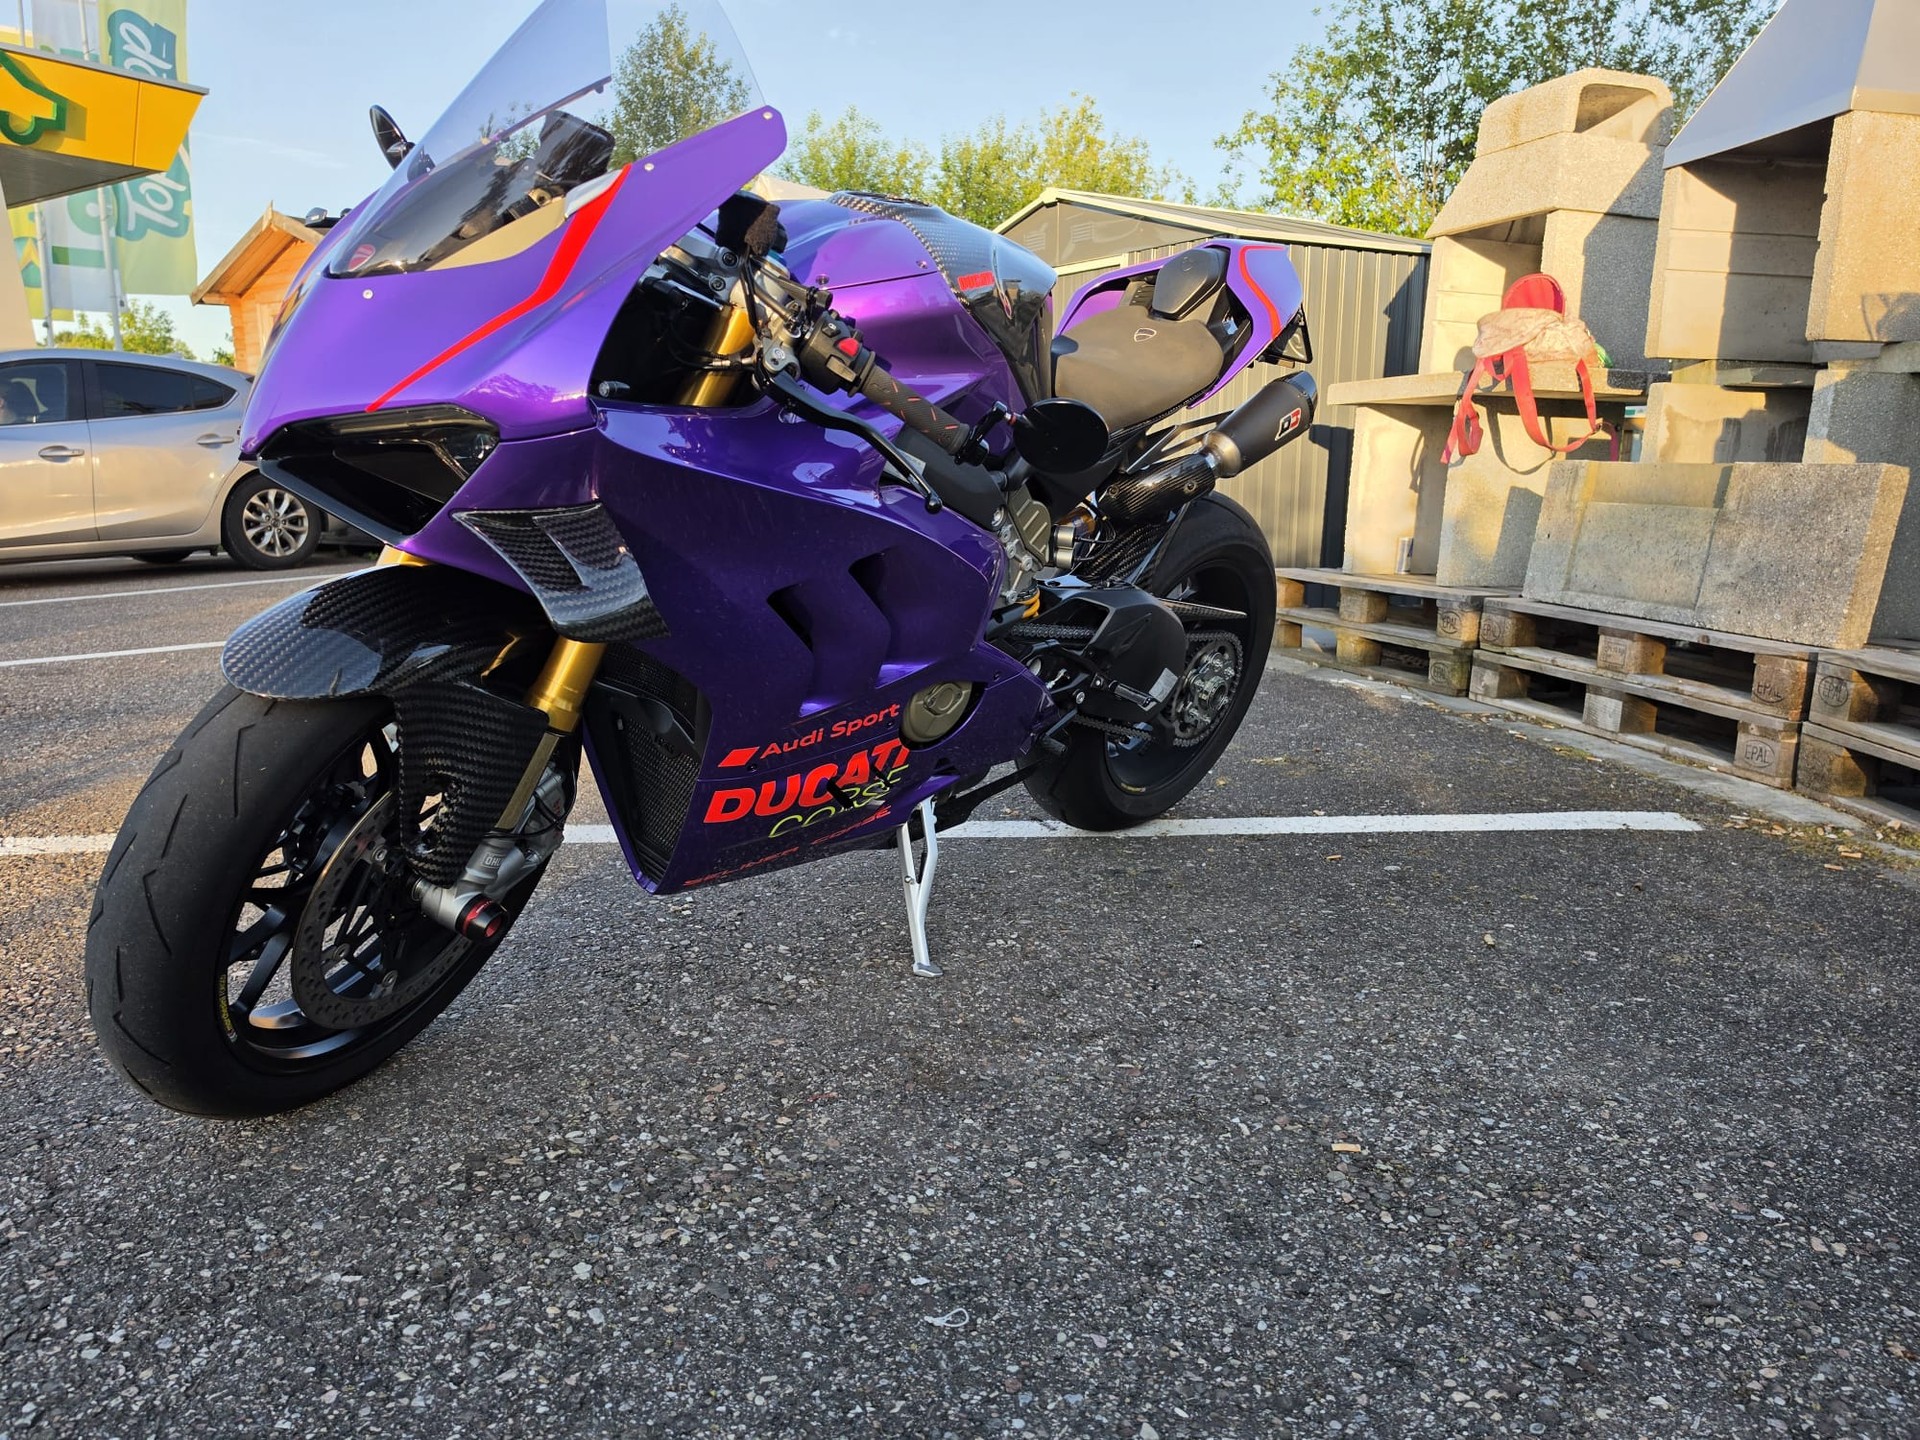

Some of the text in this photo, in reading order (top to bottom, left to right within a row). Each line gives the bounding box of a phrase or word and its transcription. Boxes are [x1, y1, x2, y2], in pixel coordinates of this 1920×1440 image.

[760, 703, 900, 759] Audi Sport
[1744, 744, 1770, 765] EPAL
[704, 738, 910, 823] DUCATI
